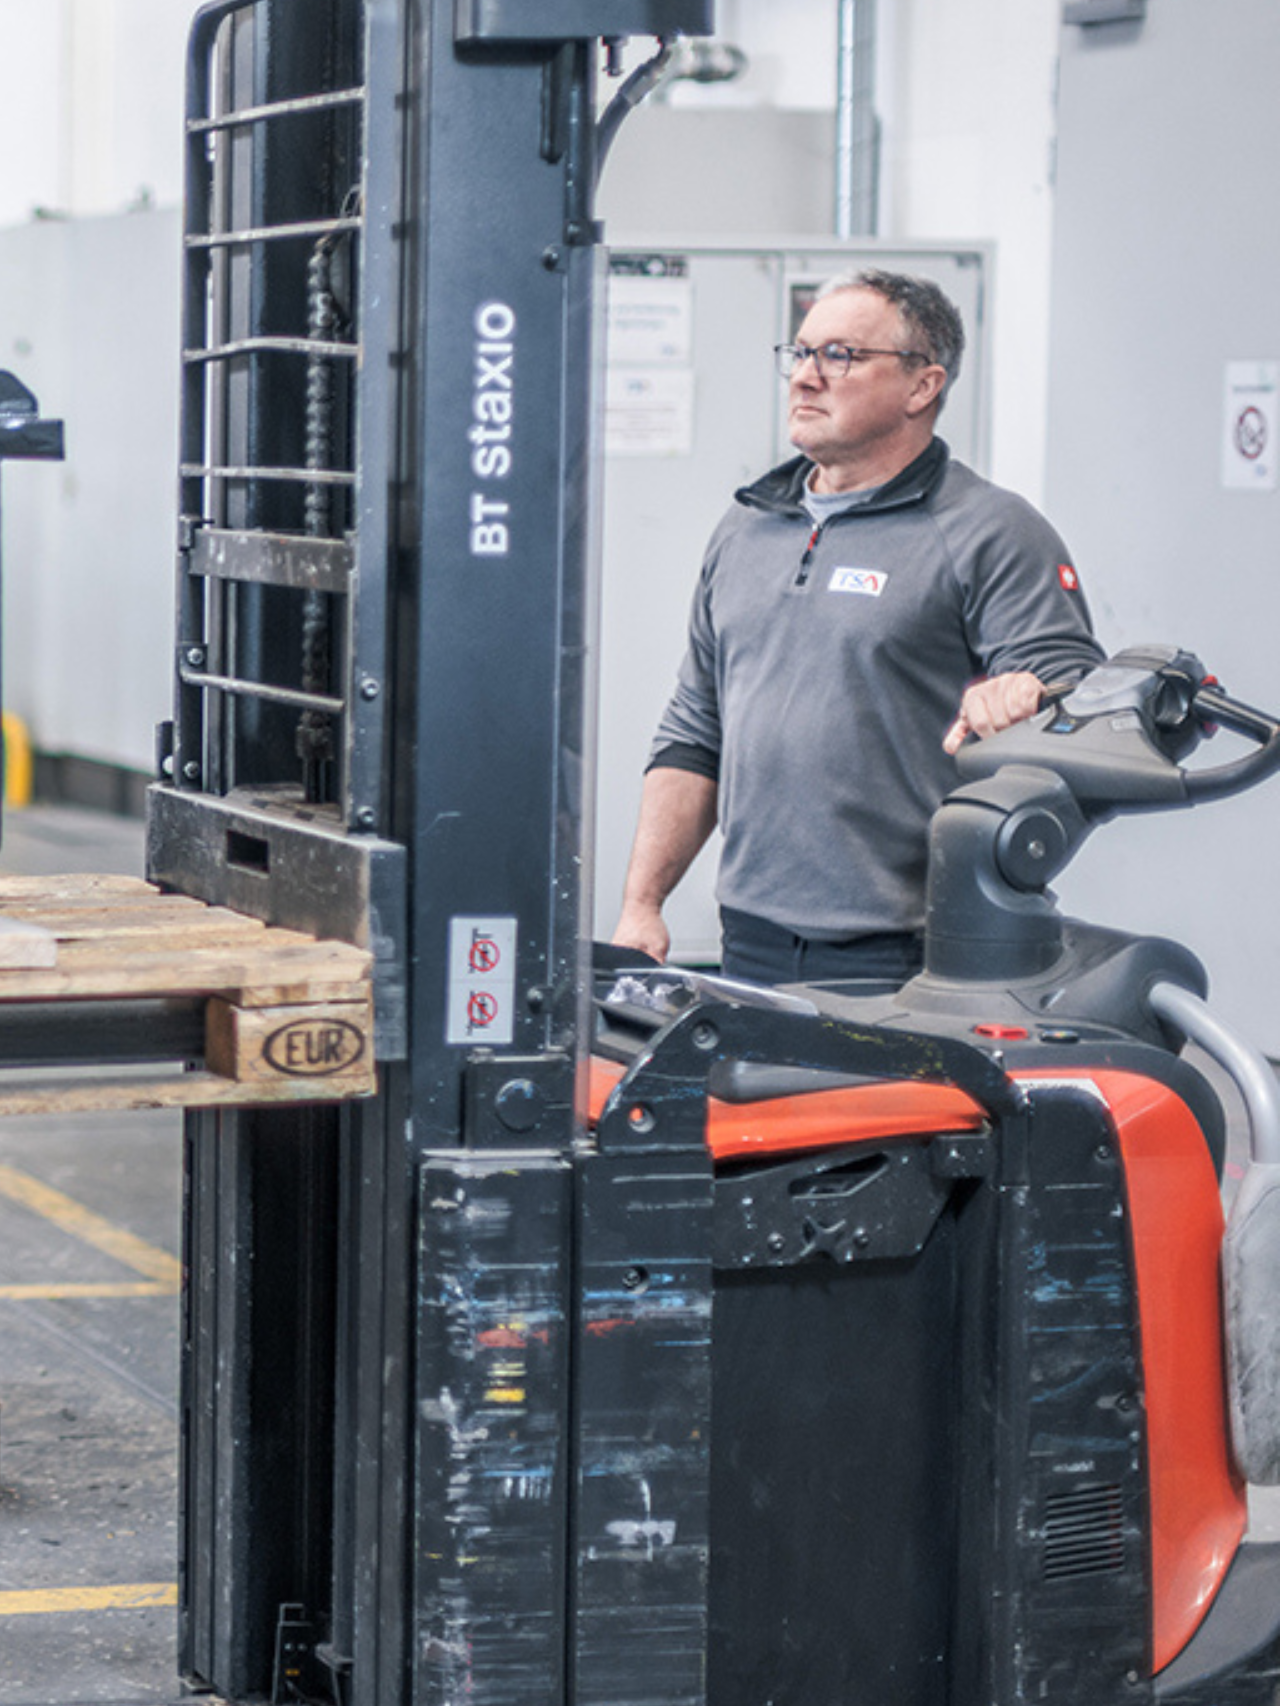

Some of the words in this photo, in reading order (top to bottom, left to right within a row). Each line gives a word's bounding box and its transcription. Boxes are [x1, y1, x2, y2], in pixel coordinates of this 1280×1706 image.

[469, 302, 516, 478] staxio
[471, 493, 509, 554] BT
[838, 571, 879, 592] TSA
[286, 1027, 344, 1066] EUR
